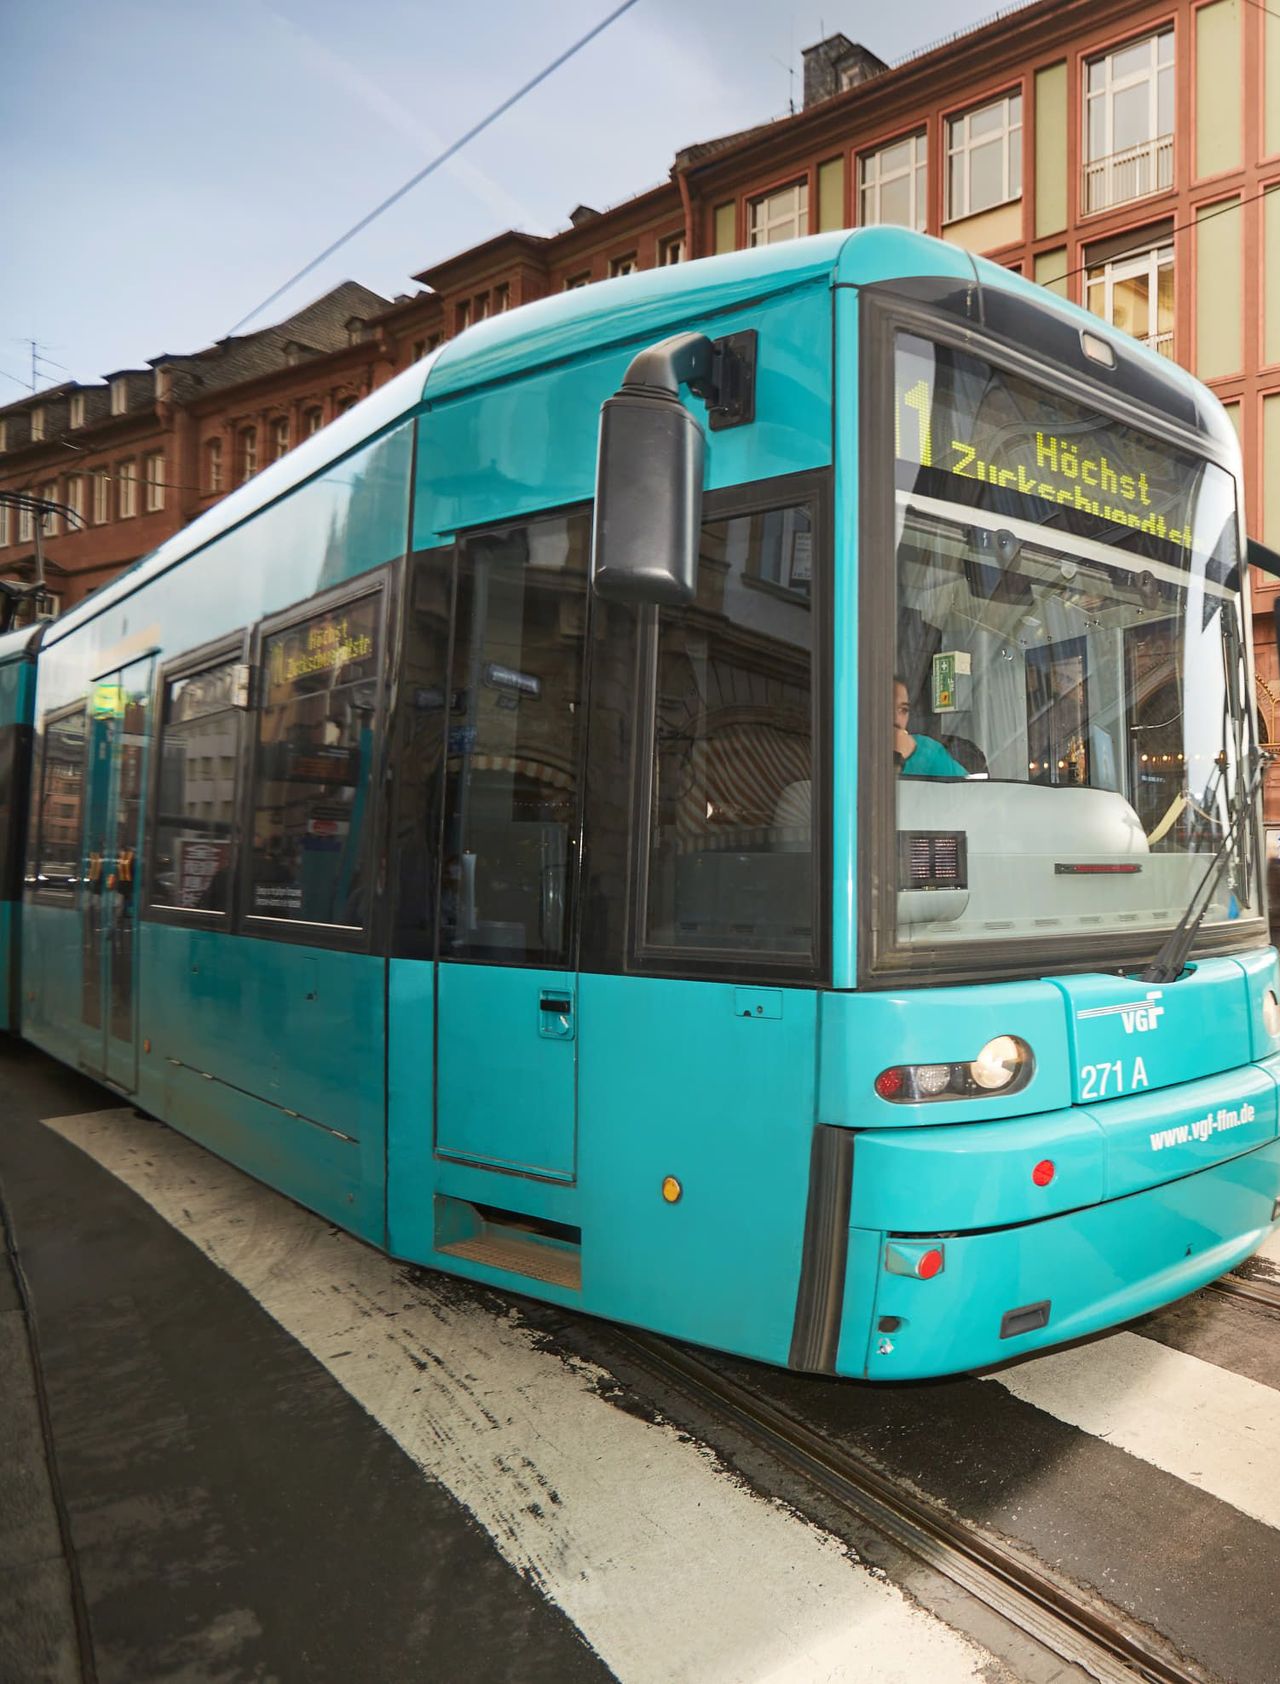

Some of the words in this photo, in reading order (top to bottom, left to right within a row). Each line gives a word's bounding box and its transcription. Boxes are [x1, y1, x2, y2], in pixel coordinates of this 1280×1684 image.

[1036, 432, 1151, 506] Höchst
[1120, 991, 1165, 1034] VGF
[1081, 1060, 1123, 1099] 271
[1131, 1056, 1149, 1089] A
[1150, 1103, 1255, 1151] www.vgf-ffm.de
